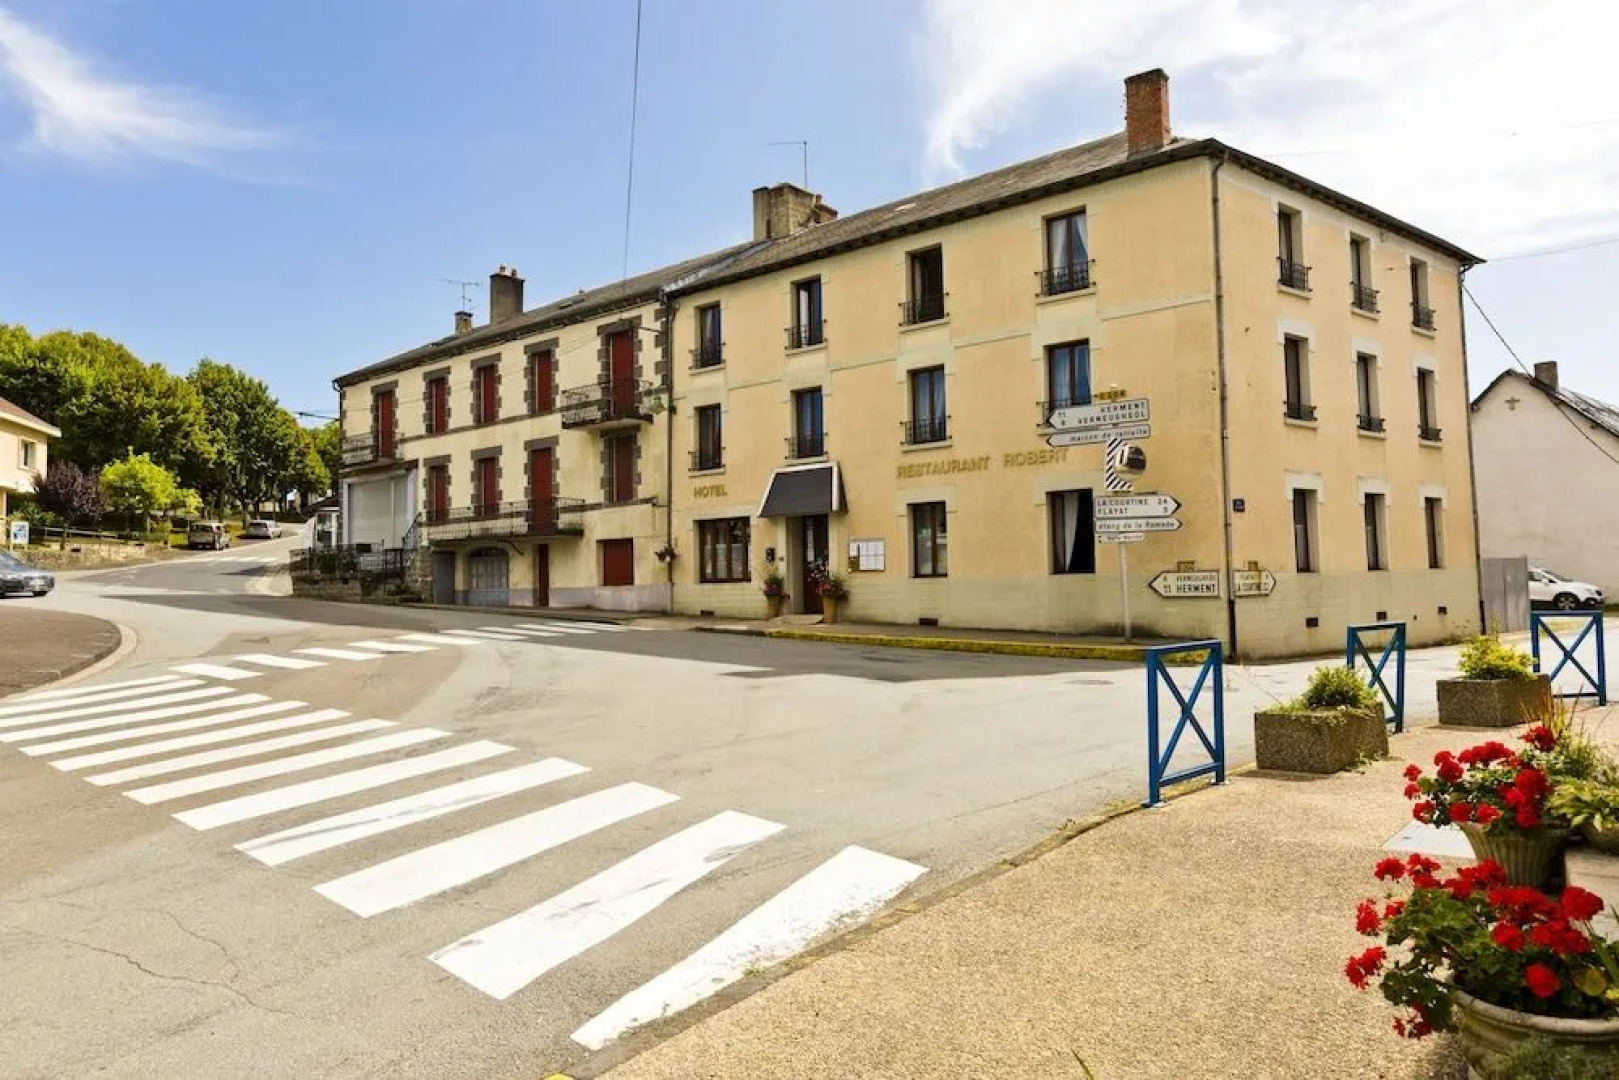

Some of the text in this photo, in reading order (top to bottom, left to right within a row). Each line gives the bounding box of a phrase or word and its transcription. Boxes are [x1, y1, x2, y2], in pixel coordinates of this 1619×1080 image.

[1101, 402, 1145, 413] HERMENT
[897, 448, 1069, 479] RESTAURANT ROBERT
[694, 485, 728, 498] HOTEL
[1097, 498, 1106, 506] LA
[1108, 498, 1149, 506] COURTINE
[1176, 583, 1216, 594] HERMENT
